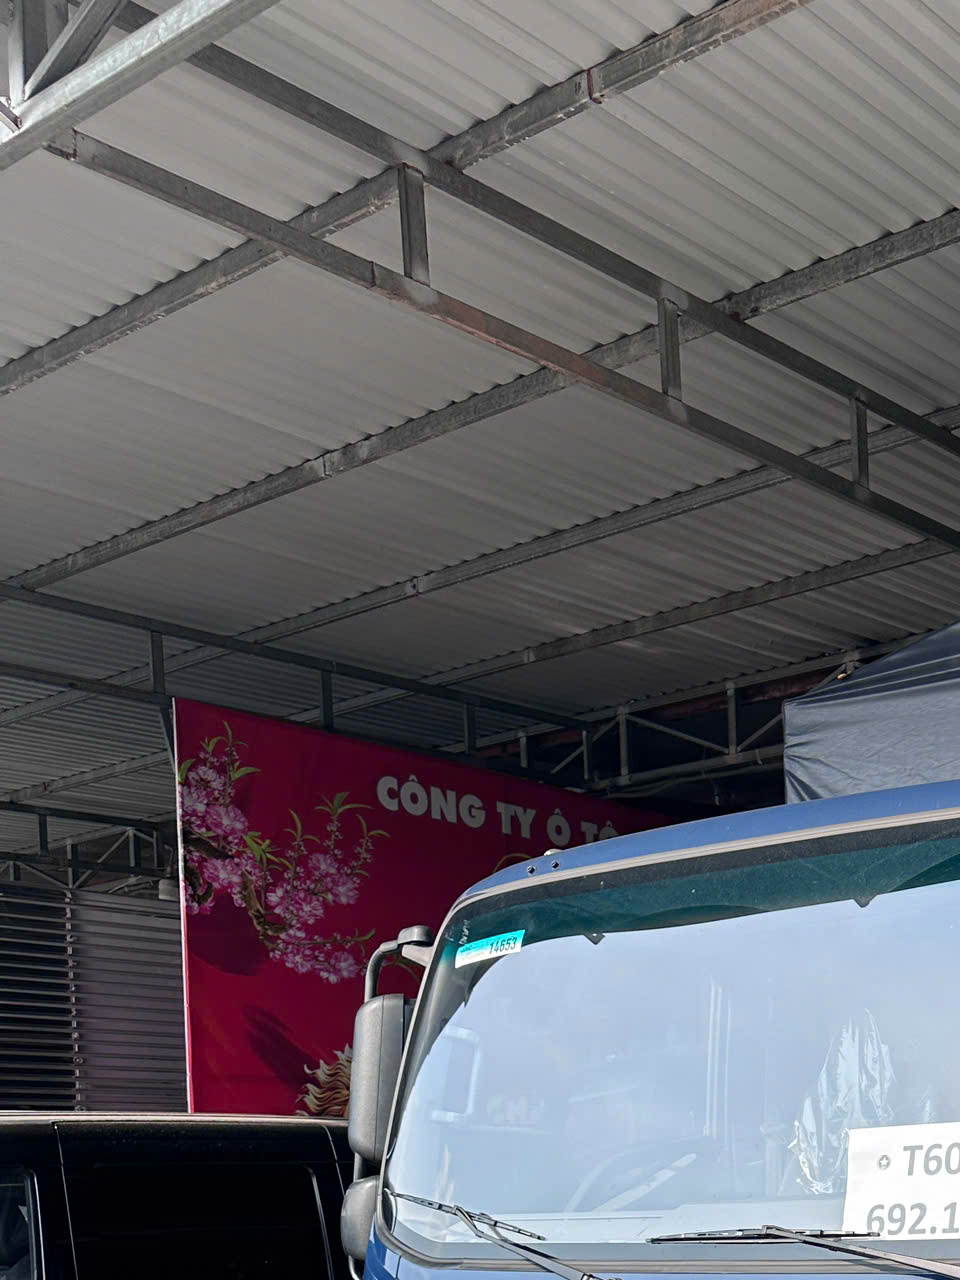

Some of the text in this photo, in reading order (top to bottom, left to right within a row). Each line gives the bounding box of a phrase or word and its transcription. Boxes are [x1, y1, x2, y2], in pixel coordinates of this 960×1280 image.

[376, 774, 487, 829] CÔNG
[496, 801, 537, 840] TY
[546, 807, 572, 847] Ô
[489, 936, 518, 955] 14653
